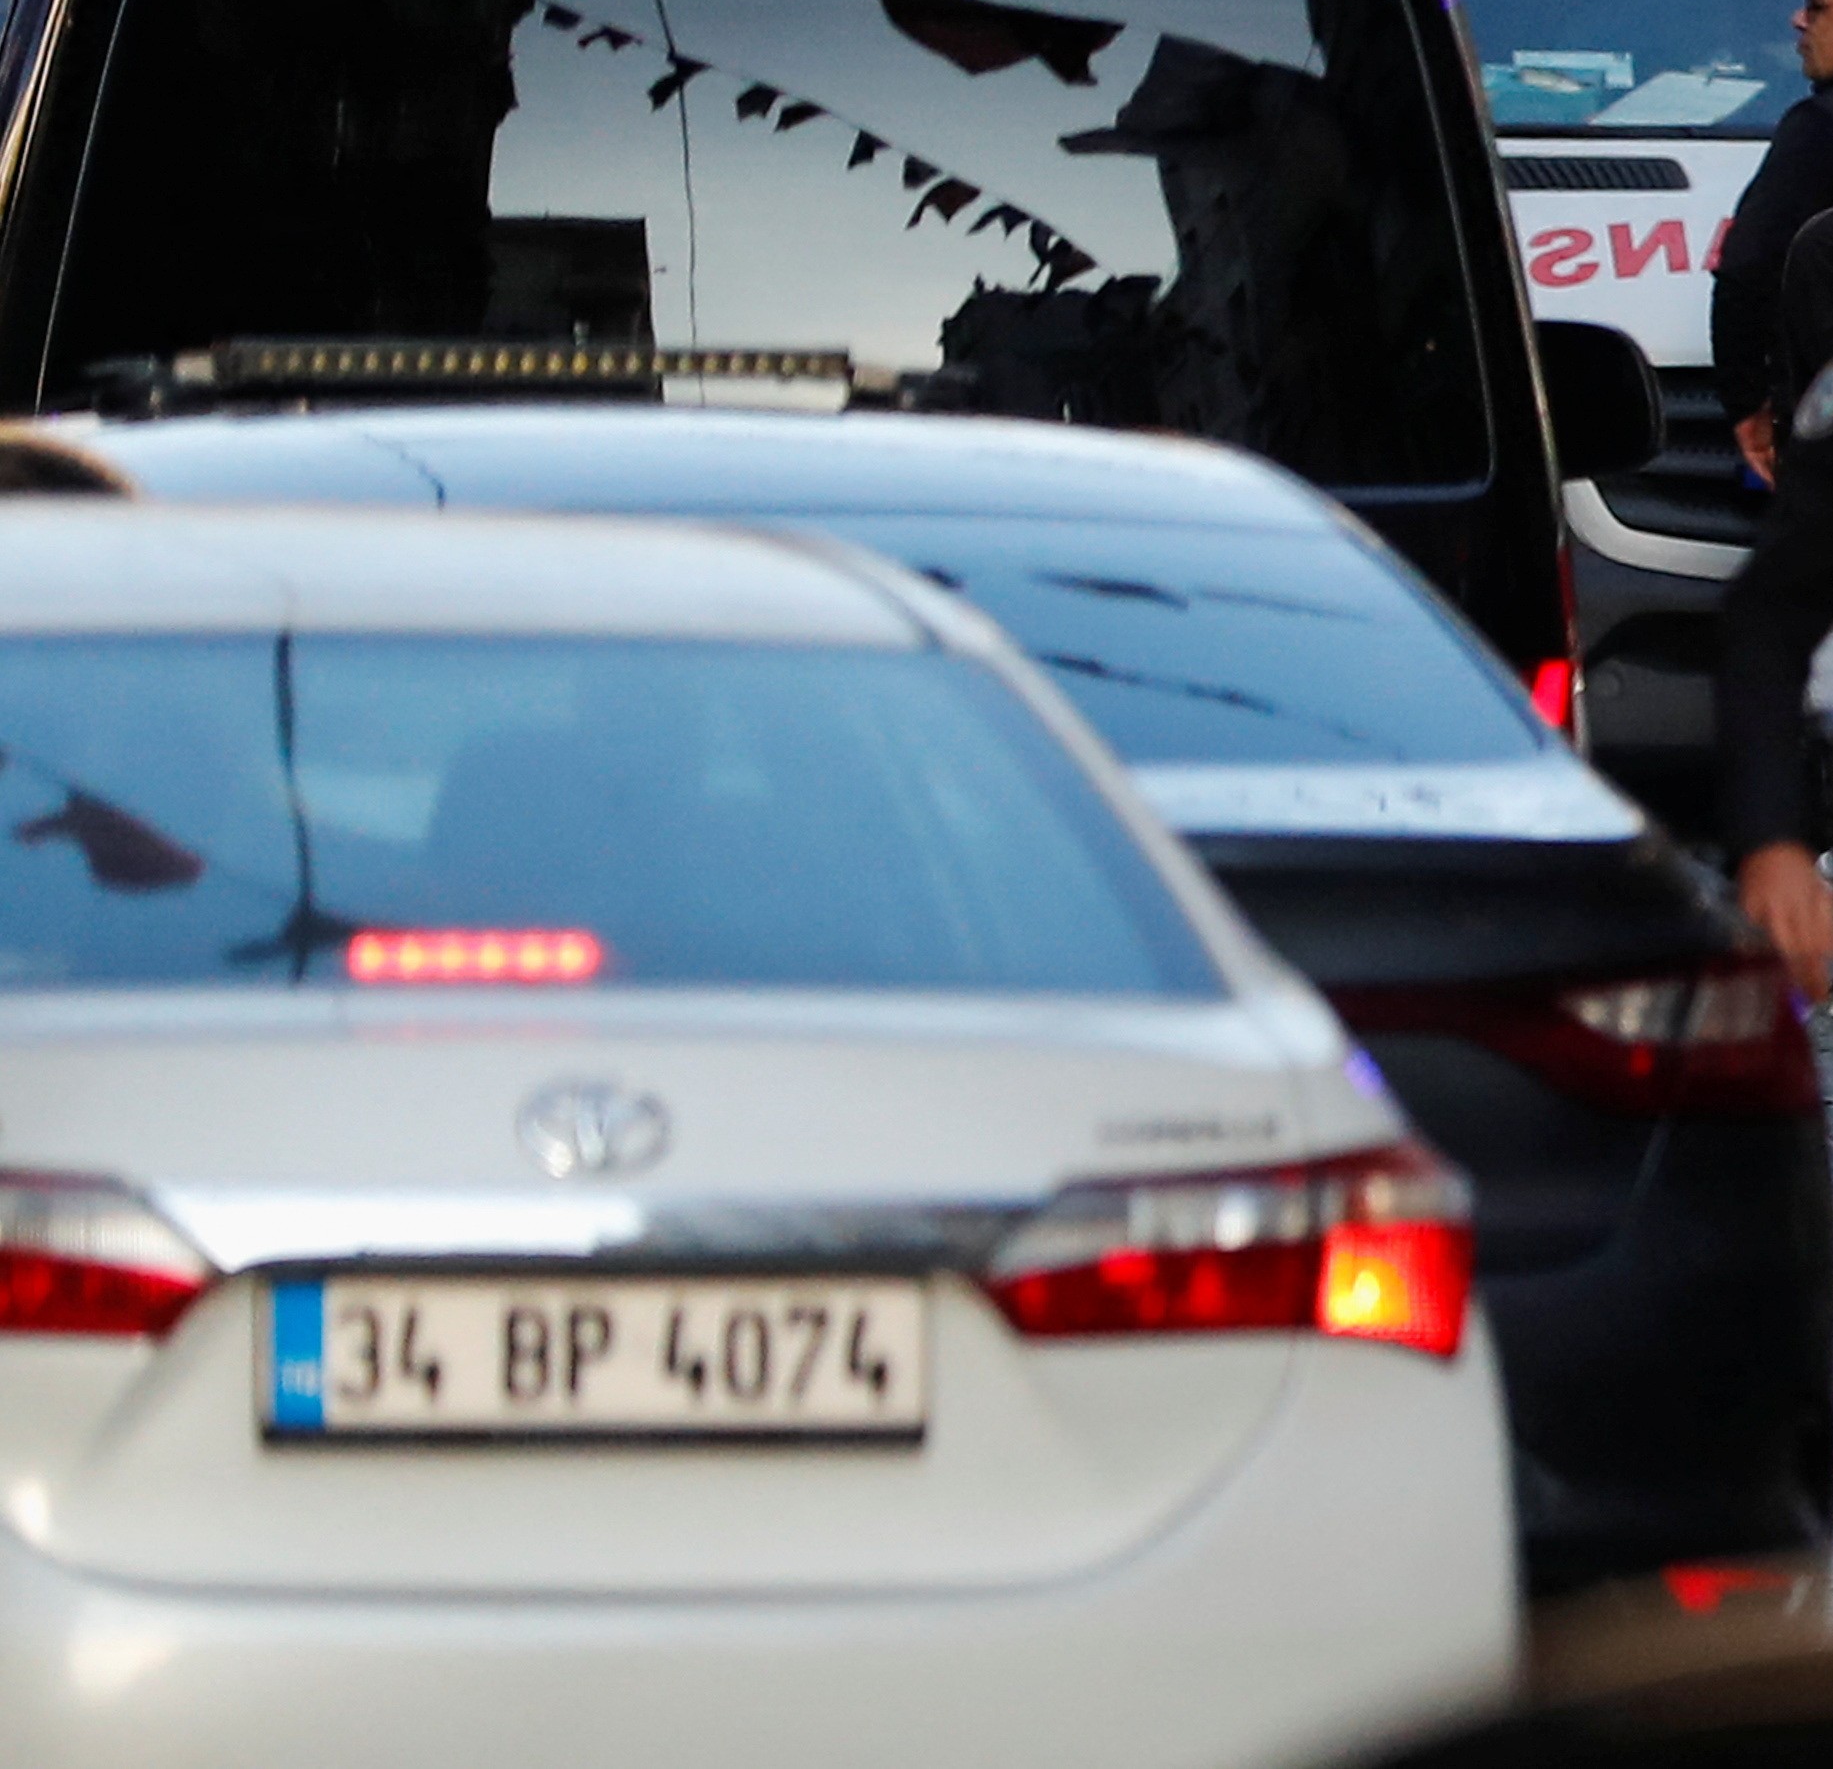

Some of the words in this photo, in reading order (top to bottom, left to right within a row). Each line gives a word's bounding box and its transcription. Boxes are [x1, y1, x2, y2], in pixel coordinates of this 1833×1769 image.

[334, 1302, 447, 1405] 34
[503, 1303, 613, 1401] BP
[662, 1302, 894, 1404] 4074
